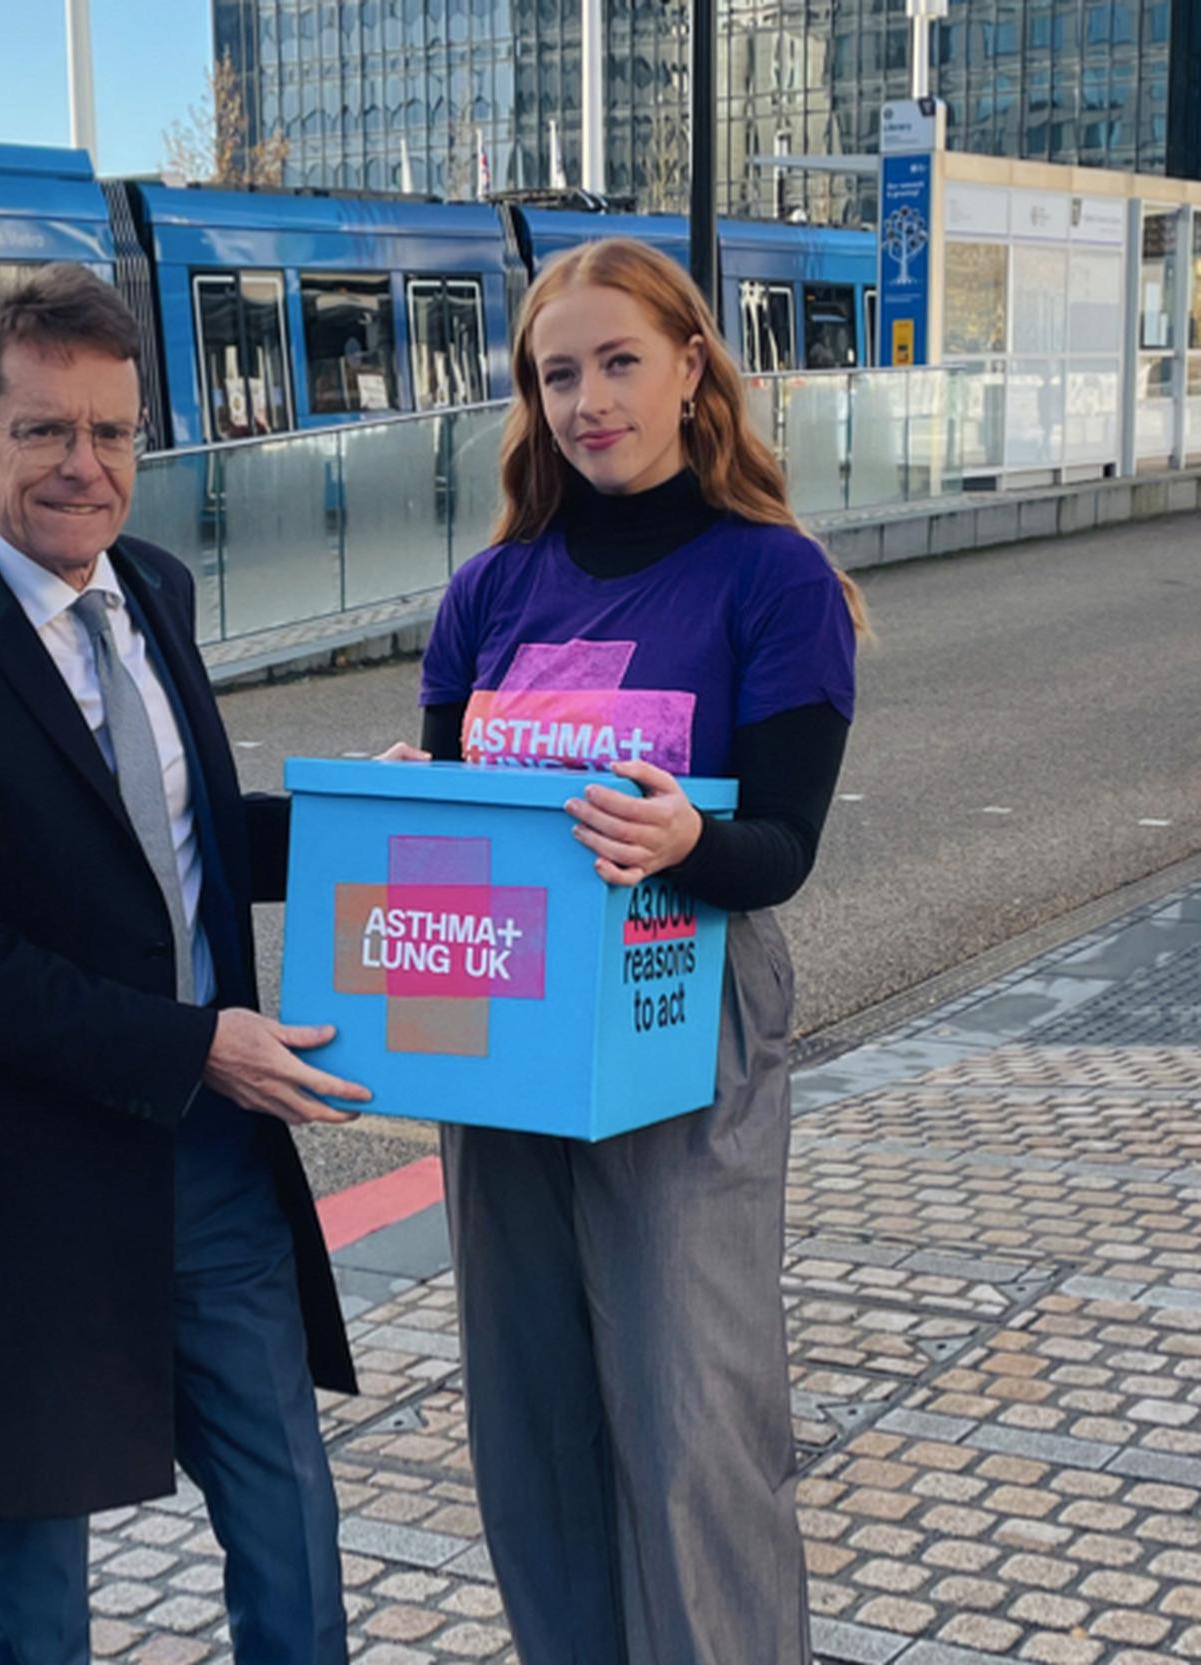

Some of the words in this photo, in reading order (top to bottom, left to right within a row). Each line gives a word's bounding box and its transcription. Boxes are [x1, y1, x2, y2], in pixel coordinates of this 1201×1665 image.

[466, 717, 654, 761] ASTHMA+
[363, 906, 523, 949] ASTHMA+
[361, 937, 451, 974] LUNG
[464, 946, 511, 981] UK
[623, 940, 696, 984] reasons
[633, 989, 654, 1034] to
[656, 982, 686, 1028] act
